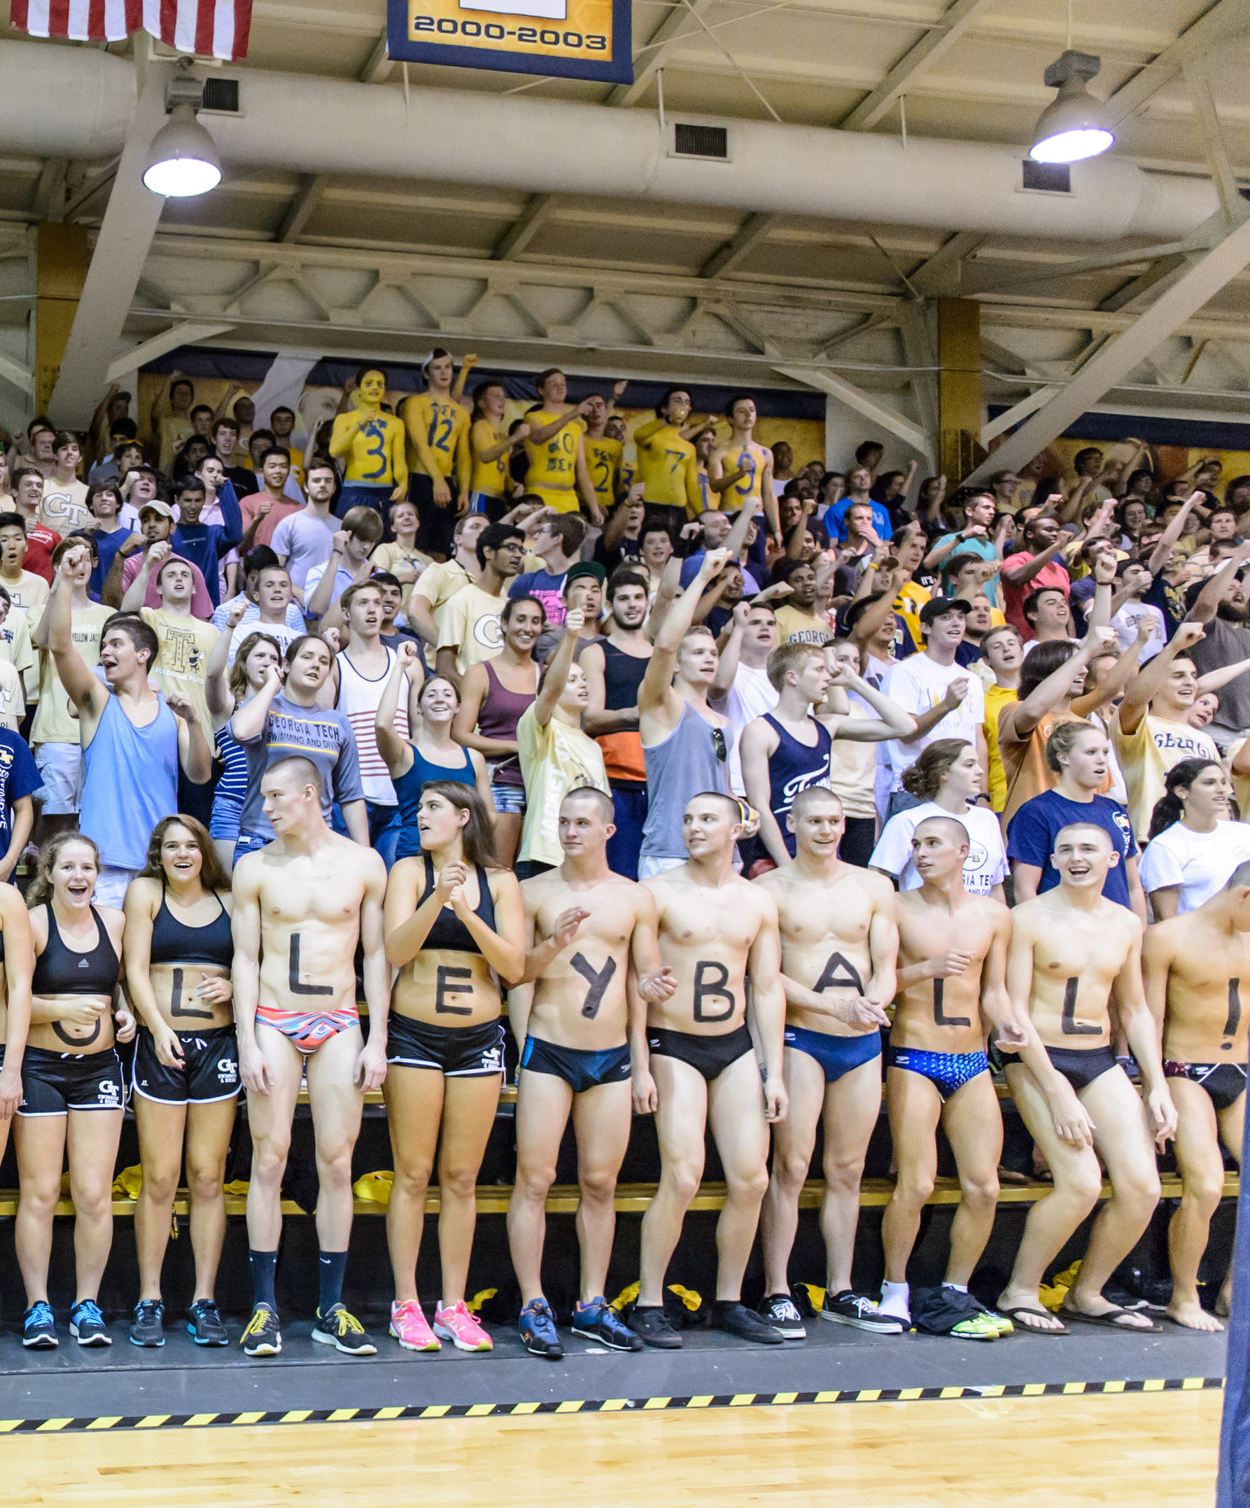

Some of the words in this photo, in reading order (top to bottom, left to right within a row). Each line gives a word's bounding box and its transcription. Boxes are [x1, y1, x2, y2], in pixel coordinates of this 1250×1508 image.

[414, 15, 607, 51] 2000-2003
[361, 425, 387, 479] 3
[427, 410, 453, 453] 12
[594, 461, 610, 493] 2
[666, 449, 686, 473] 7
[43, 492, 88, 526] GT
[269, 714, 310, 736] GEORGIA
[314, 724, 340, 741] TECH
[306, 737, 322, 748] AND
[289, 932, 334, 995] L
[569, 951, 617, 1020] Y
[812, 951, 865, 997] A
[170, 967, 214, 1020] L
[436, 965, 474, 1015] E
[693, 961, 736, 1023] B
[933, 977, 972, 1027] L
[1061, 976, 1103, 1035] L
[1220, 977, 1241, 1051] !
[99, 1080, 119, 1097] GT
[218, 1059, 238, 1074] GT
